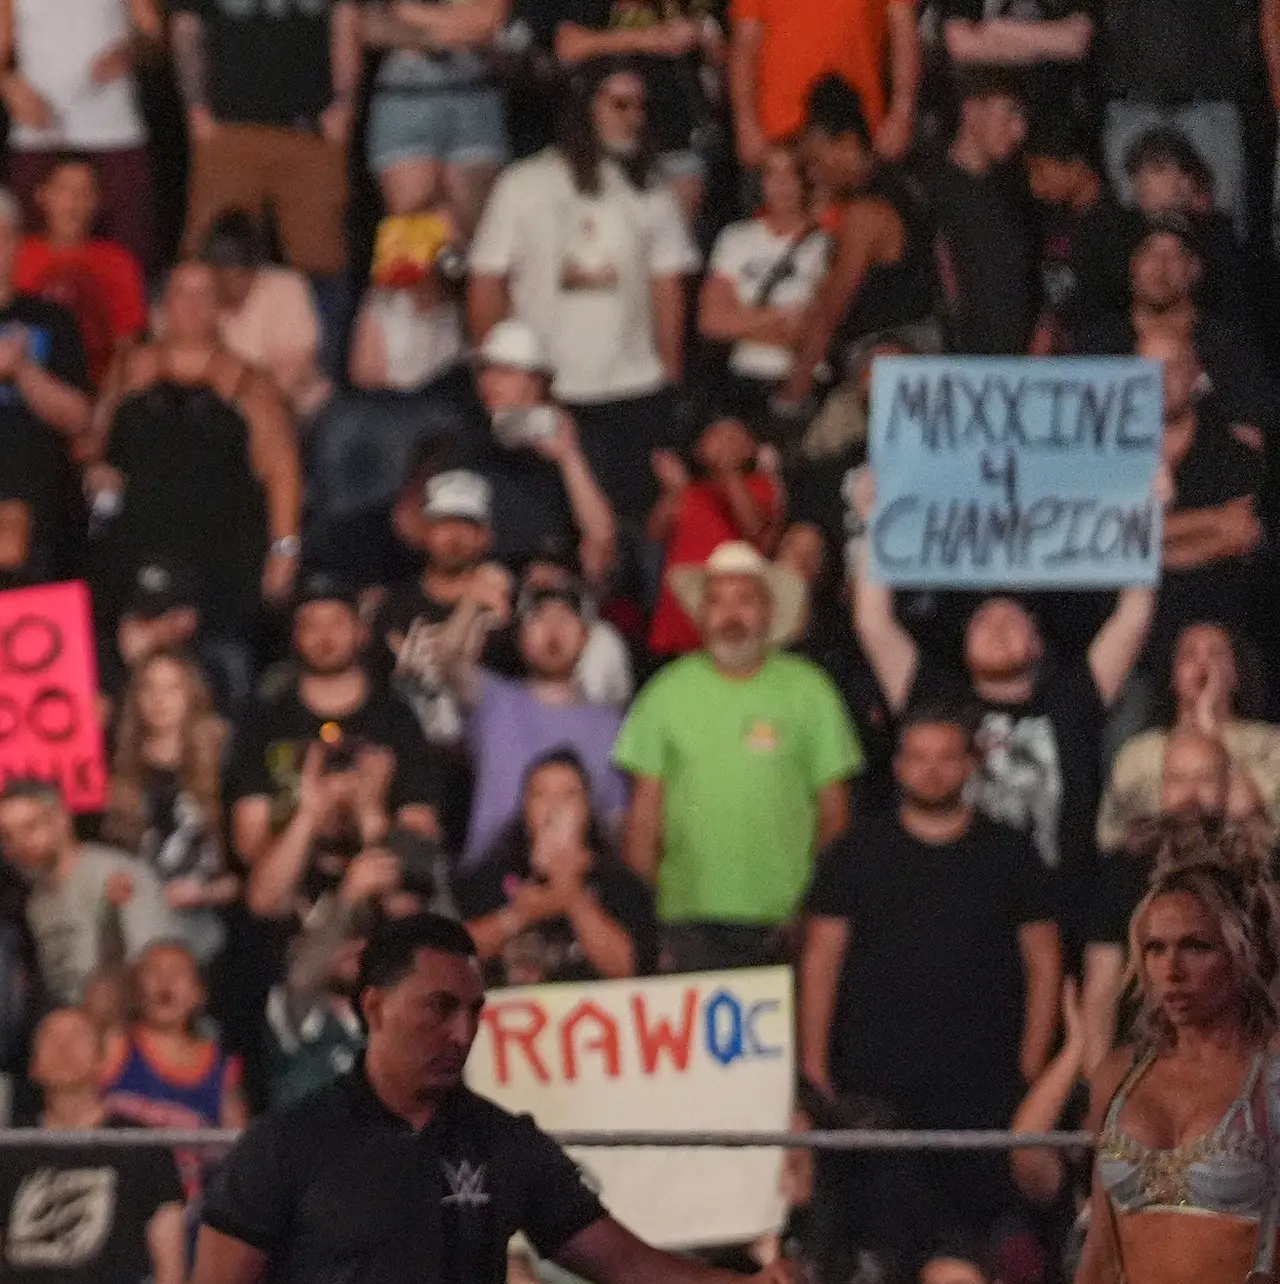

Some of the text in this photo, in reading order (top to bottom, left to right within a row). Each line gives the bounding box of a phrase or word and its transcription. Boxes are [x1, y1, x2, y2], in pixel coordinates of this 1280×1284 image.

[887, 369, 1155, 448] MAXXINE
[980, 447, 1019, 501] 4
[873, 495, 1154, 569] CHAMPION
